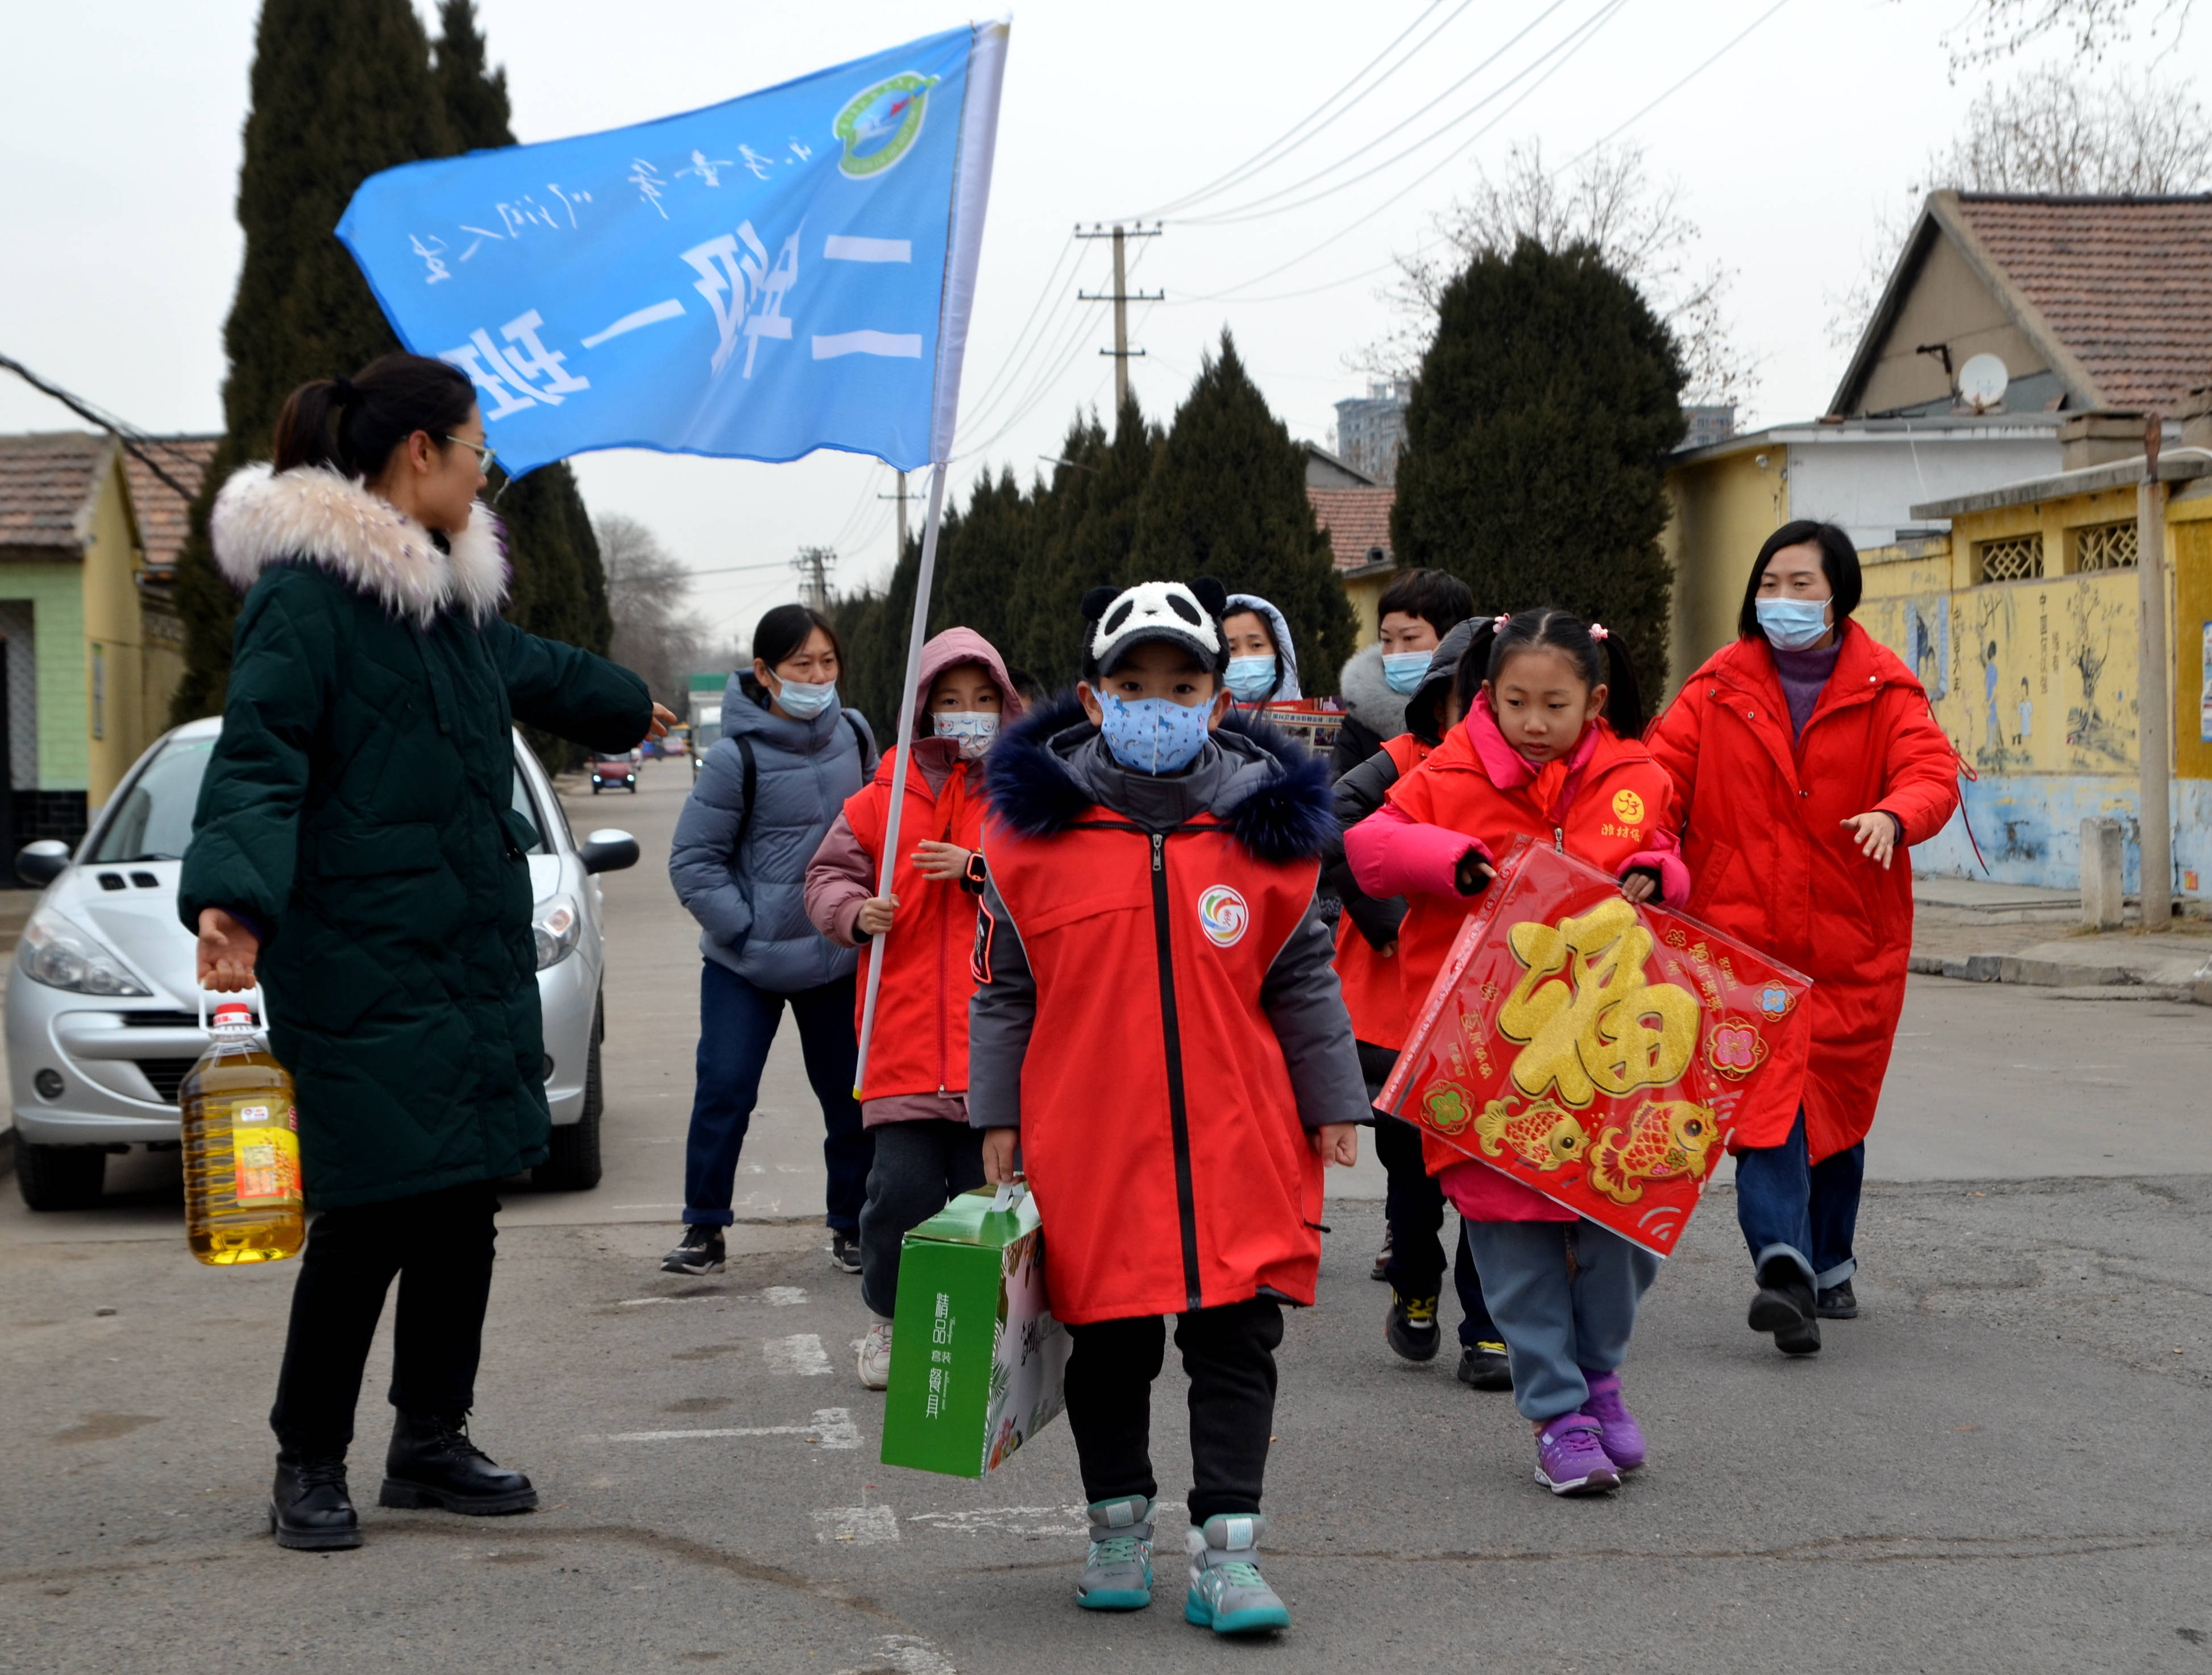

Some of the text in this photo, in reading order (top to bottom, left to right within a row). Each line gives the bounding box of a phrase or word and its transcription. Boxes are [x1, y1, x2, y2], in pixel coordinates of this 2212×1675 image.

[1496, 897, 1701, 1109] 福
[932, 1292, 949, 1345] 精品
[926, 1367, 942, 1420] 餐具
